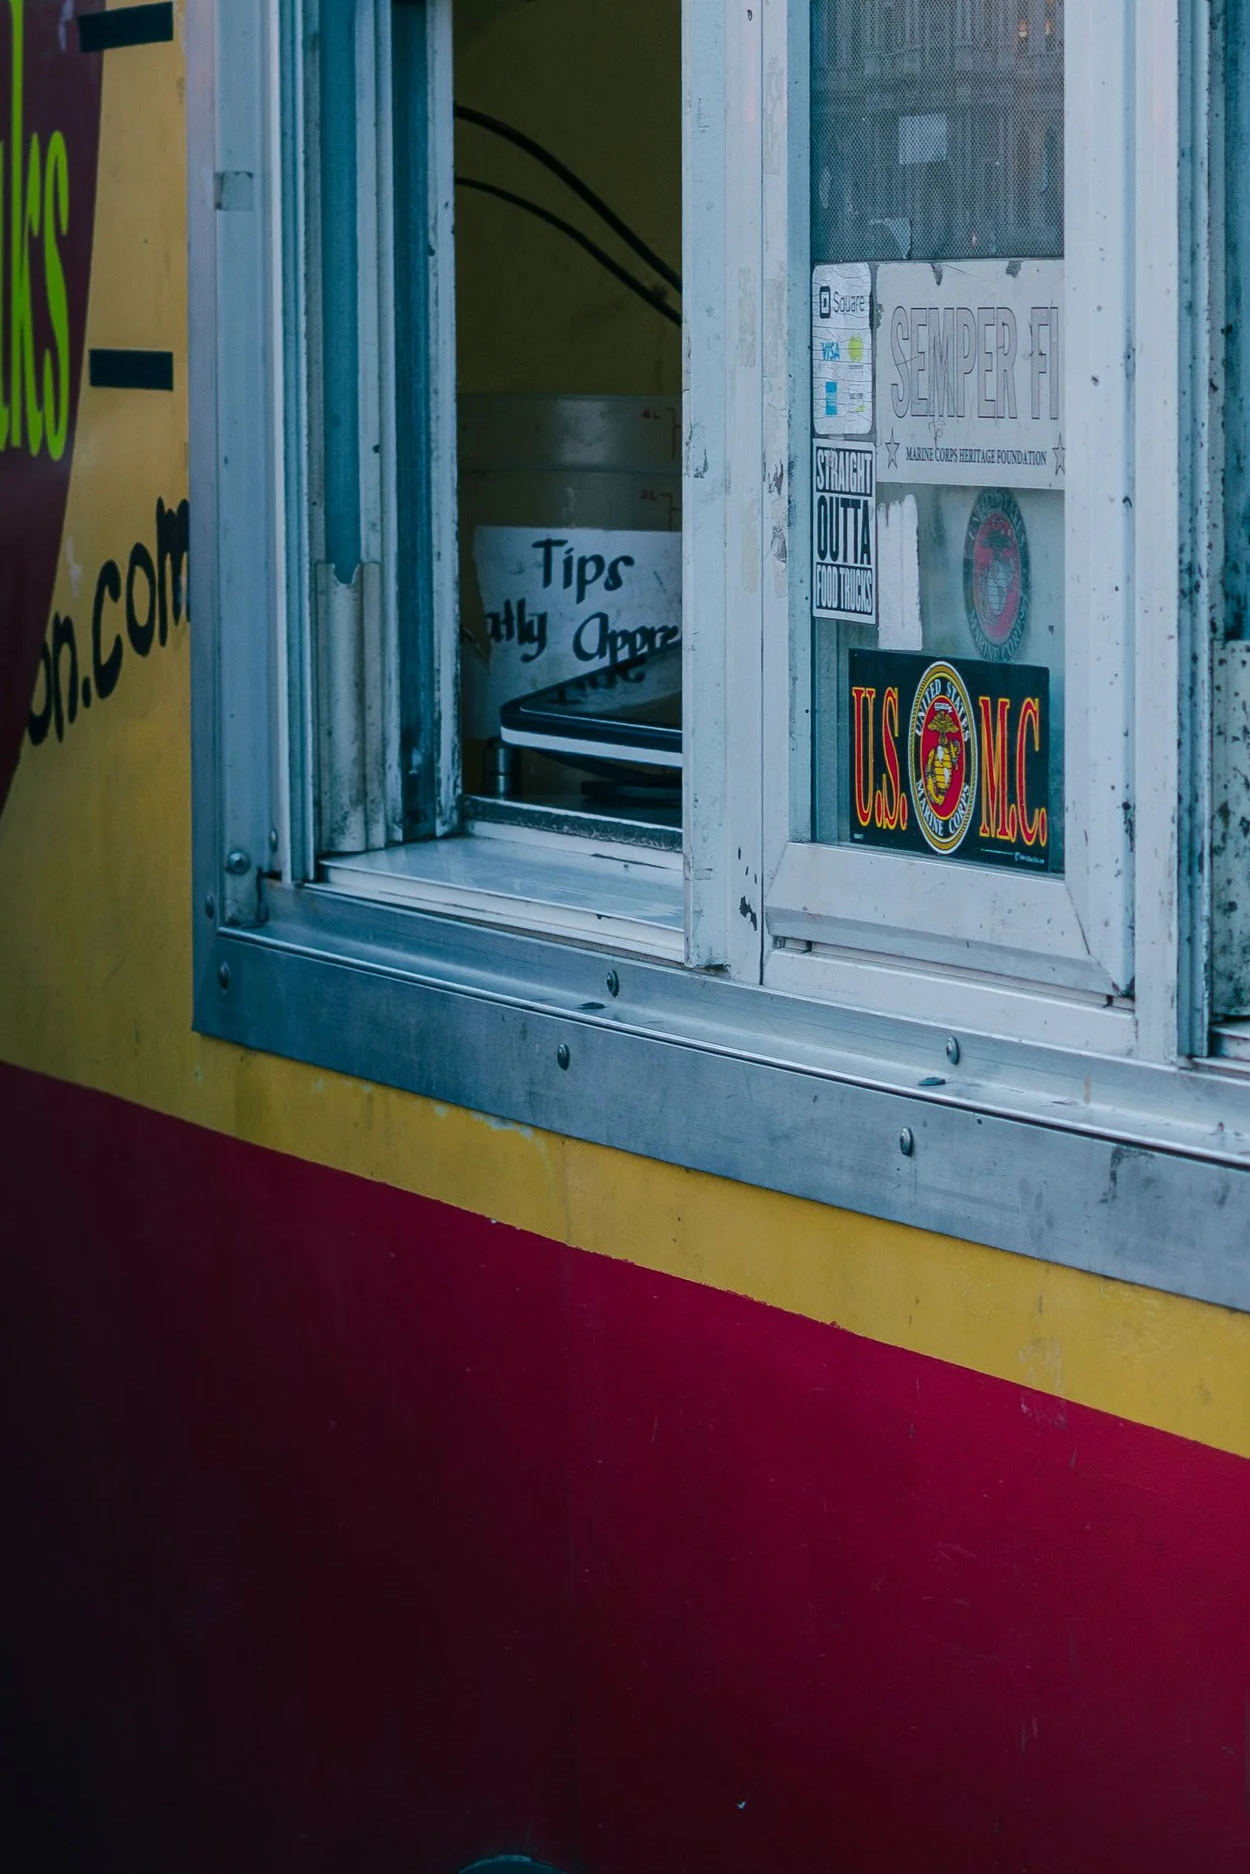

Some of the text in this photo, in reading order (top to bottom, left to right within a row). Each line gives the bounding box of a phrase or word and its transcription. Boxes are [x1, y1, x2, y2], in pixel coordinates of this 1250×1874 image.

[832, 290, 866, 317] Square
[821, 341, 840, 361] VISA
[890, 304, 1059, 420] SEMPER FI
[816, 448, 873, 496] STRAIGHT
[906, 446, 1048, 466] MARINE CORPS HERITAGE FOUNDATION
[817, 494, 872, 566] OUTTA
[532, 538, 635, 604] Tips
[816, 564, 873, 614] FOOD TRUCKS
[915, 678, 971, 743] UNITED STATES
[851, 686, 1048, 848] U.S. M.C.
[916, 778, 971, 838] MARINE CORPS
